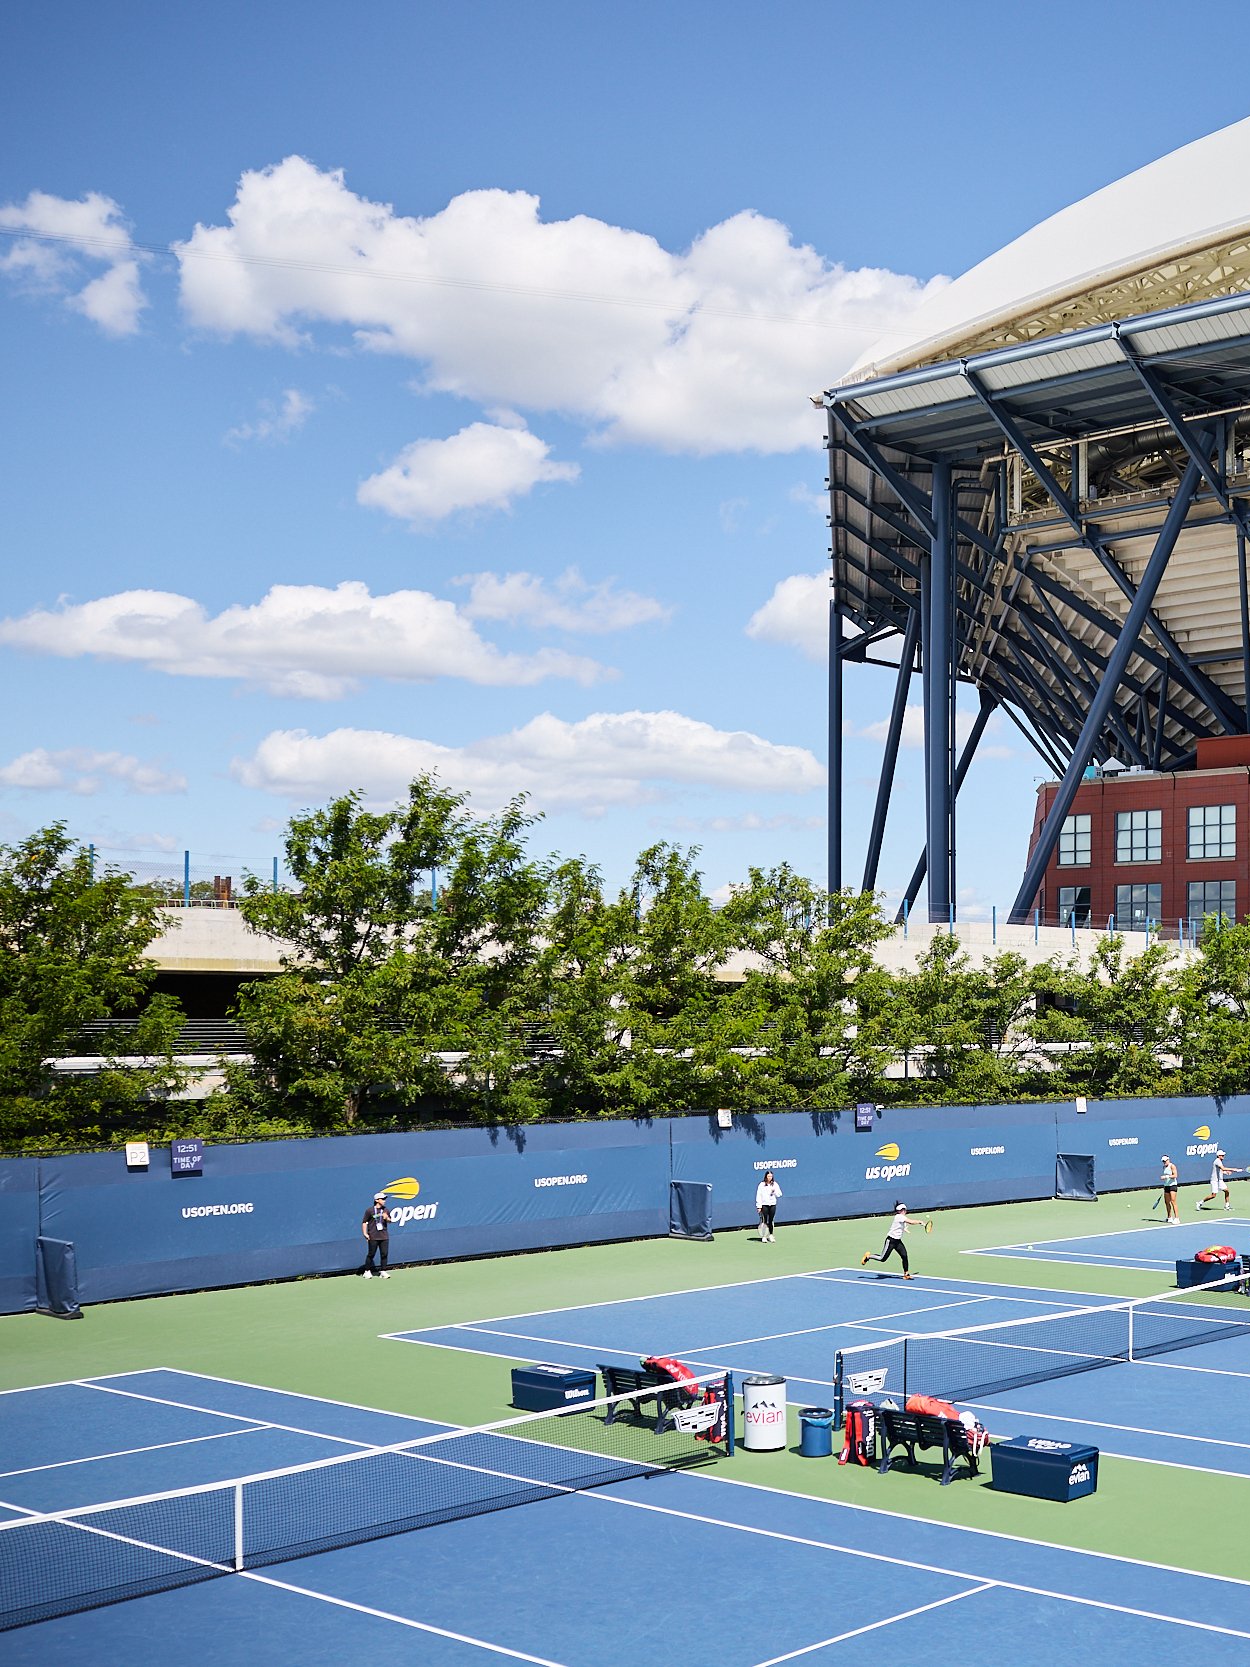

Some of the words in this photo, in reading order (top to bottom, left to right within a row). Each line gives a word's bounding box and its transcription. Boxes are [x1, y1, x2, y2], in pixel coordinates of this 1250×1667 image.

[177, 1144, 197, 1153] 12:51
[971, 1146, 1005, 1156] USOPEN.ORG
[1197, 1143, 1218, 1157] open
[130, 1151, 147, 1163] P2
[753, 1159, 797, 1170] USOPEN.ORG
[880, 1163, 911, 1181] open
[534, 1174, 588, 1188] USOPEN.ORG
[181, 1203, 254, 1218] USOPEN.ORG
[389, 1203, 437, 1227] open
[746, 1410, 784, 1423] evian
[1068, 1470, 1090, 1486] evian
